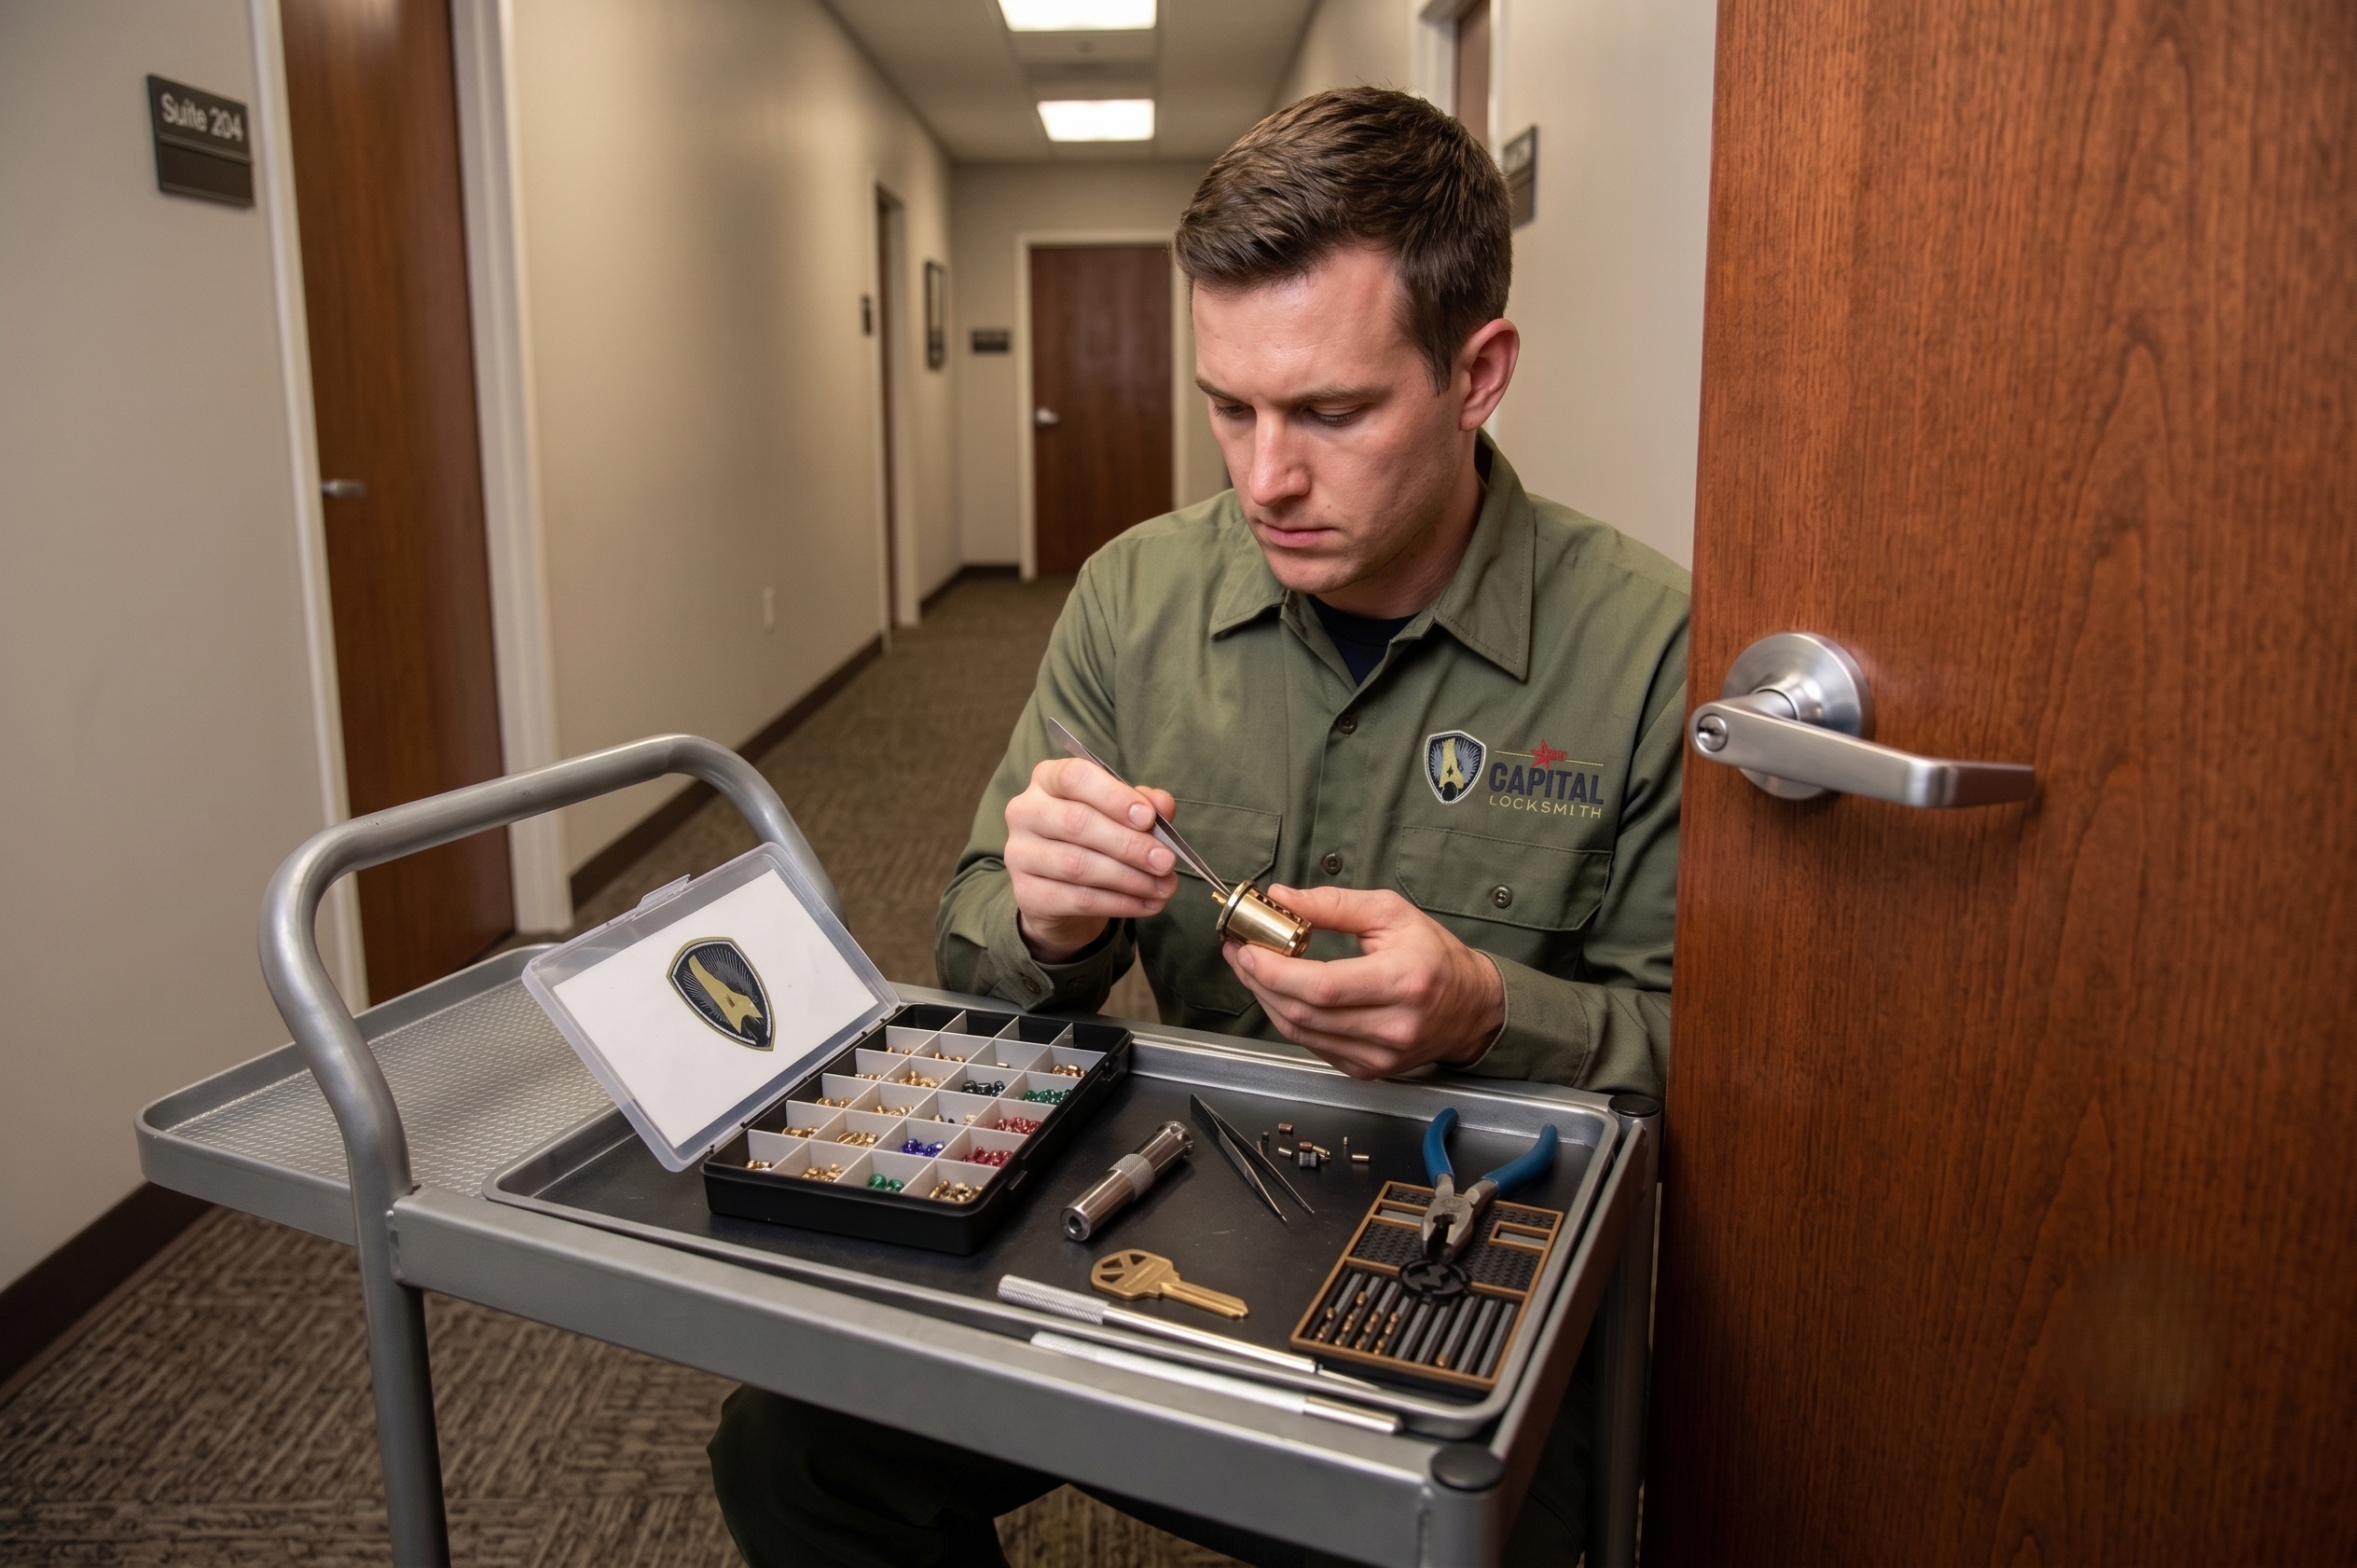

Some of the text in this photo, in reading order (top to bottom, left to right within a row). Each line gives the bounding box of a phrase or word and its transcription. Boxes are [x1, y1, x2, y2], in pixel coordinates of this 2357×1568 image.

[160, 92, 243, 142] Suite 204
[1489, 762, 1604, 805] CAPITAL
[1489, 795, 1602, 818] LOCKSMITH
